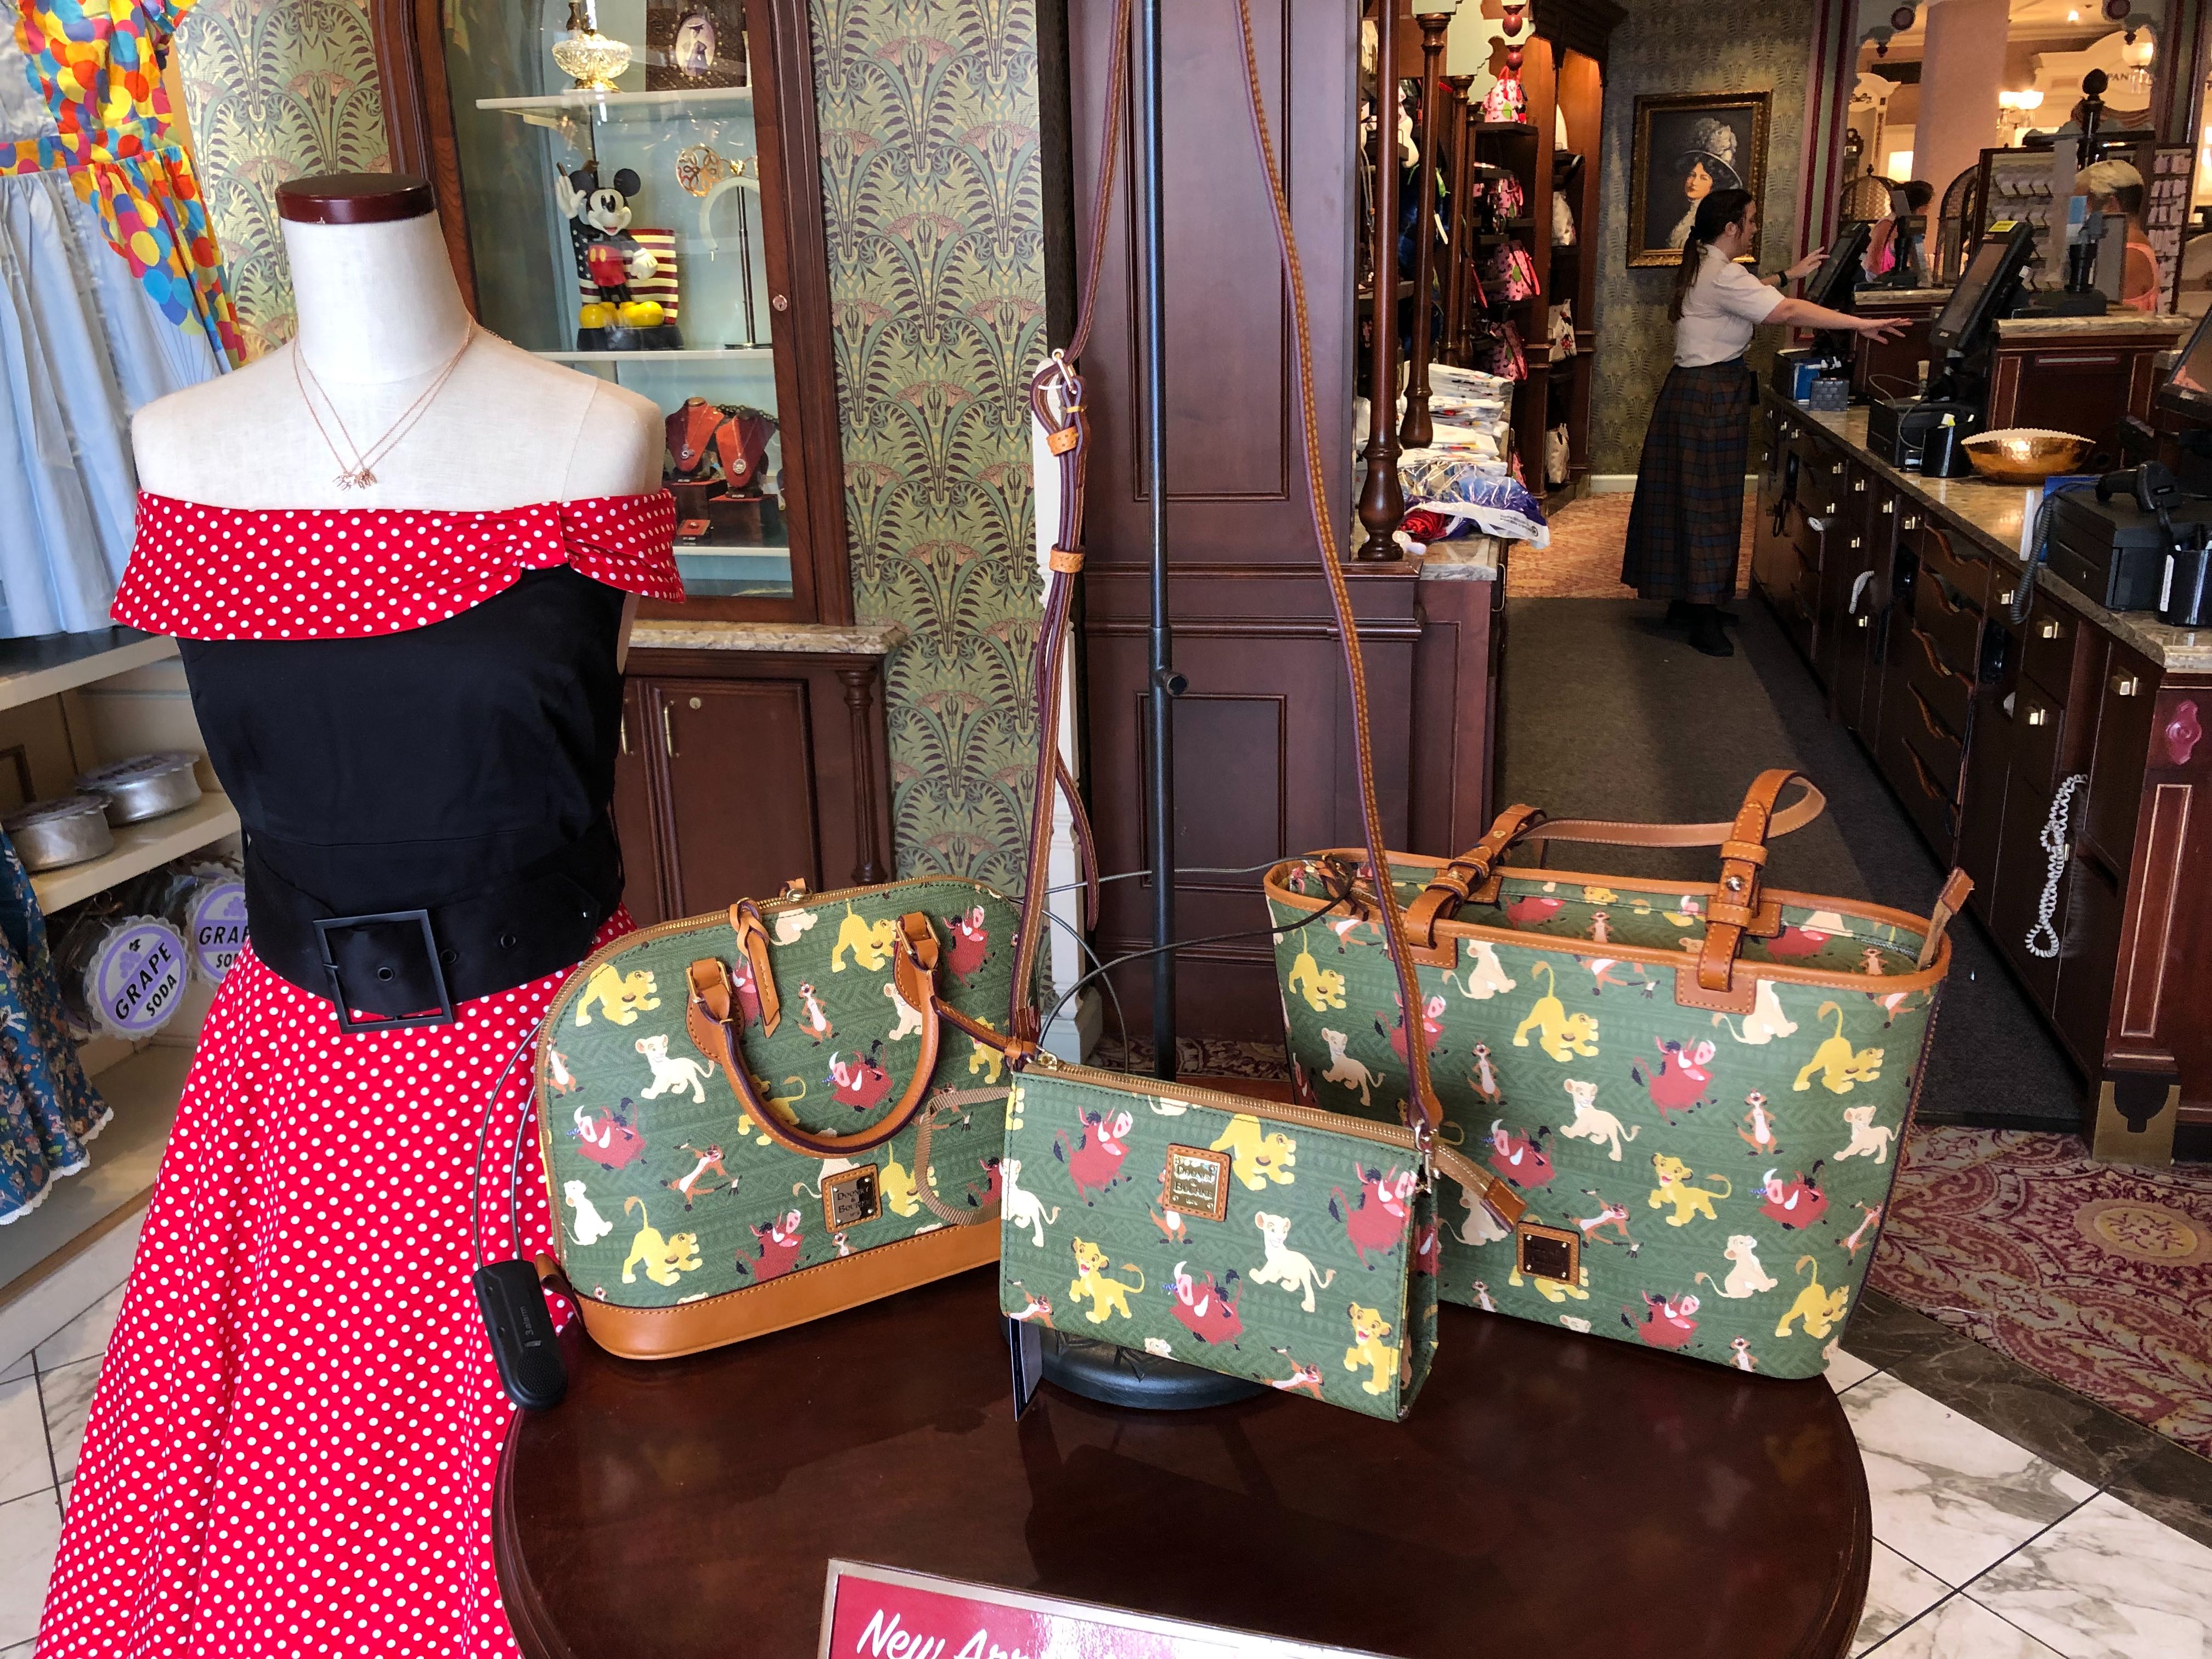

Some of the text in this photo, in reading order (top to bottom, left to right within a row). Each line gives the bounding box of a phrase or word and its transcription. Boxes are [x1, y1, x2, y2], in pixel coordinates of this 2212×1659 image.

[199, 926, 249, 945] GRAP
[115, 943, 172, 1020] GRAPE
[216, 953, 239, 968] SO
[146, 974, 177, 1017] SODA
[856, 1609, 946, 1659] New
